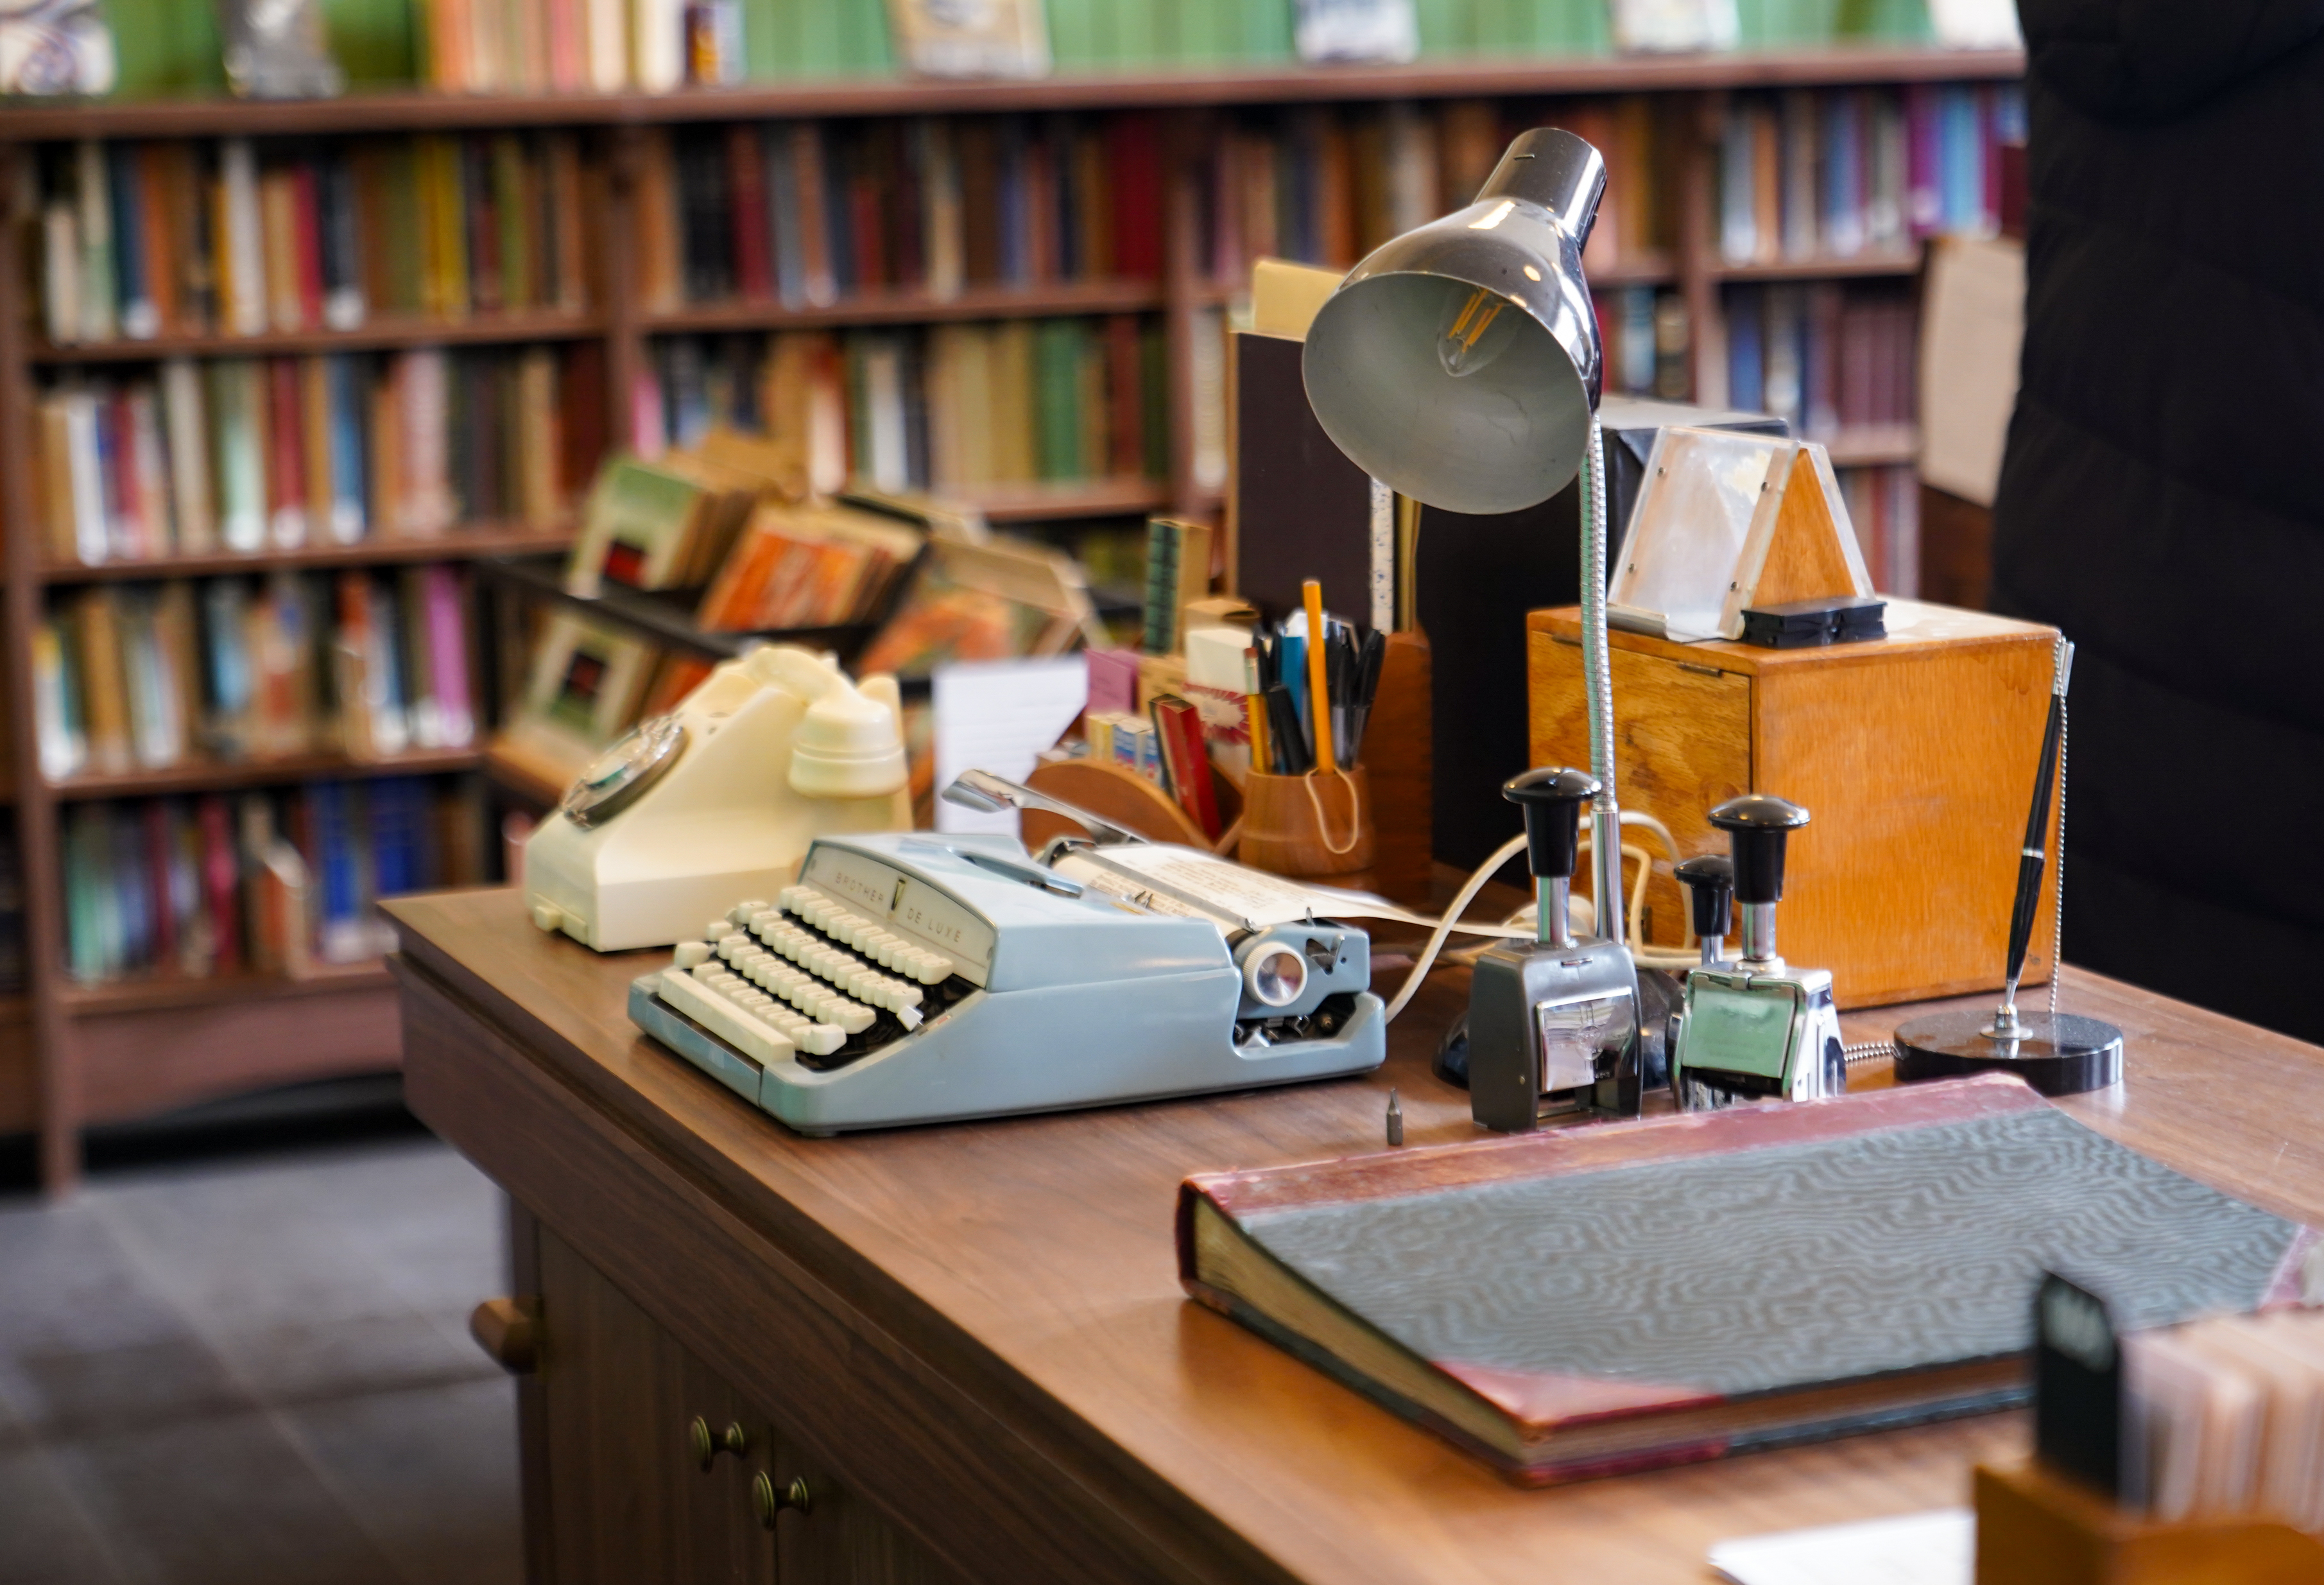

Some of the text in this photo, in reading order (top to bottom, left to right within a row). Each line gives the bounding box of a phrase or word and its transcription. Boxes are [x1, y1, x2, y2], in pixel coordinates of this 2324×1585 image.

[836, 872, 884, 902] BROTHER
[906, 907, 922, 924] DE
[928, 918, 961, 943] LUXE
